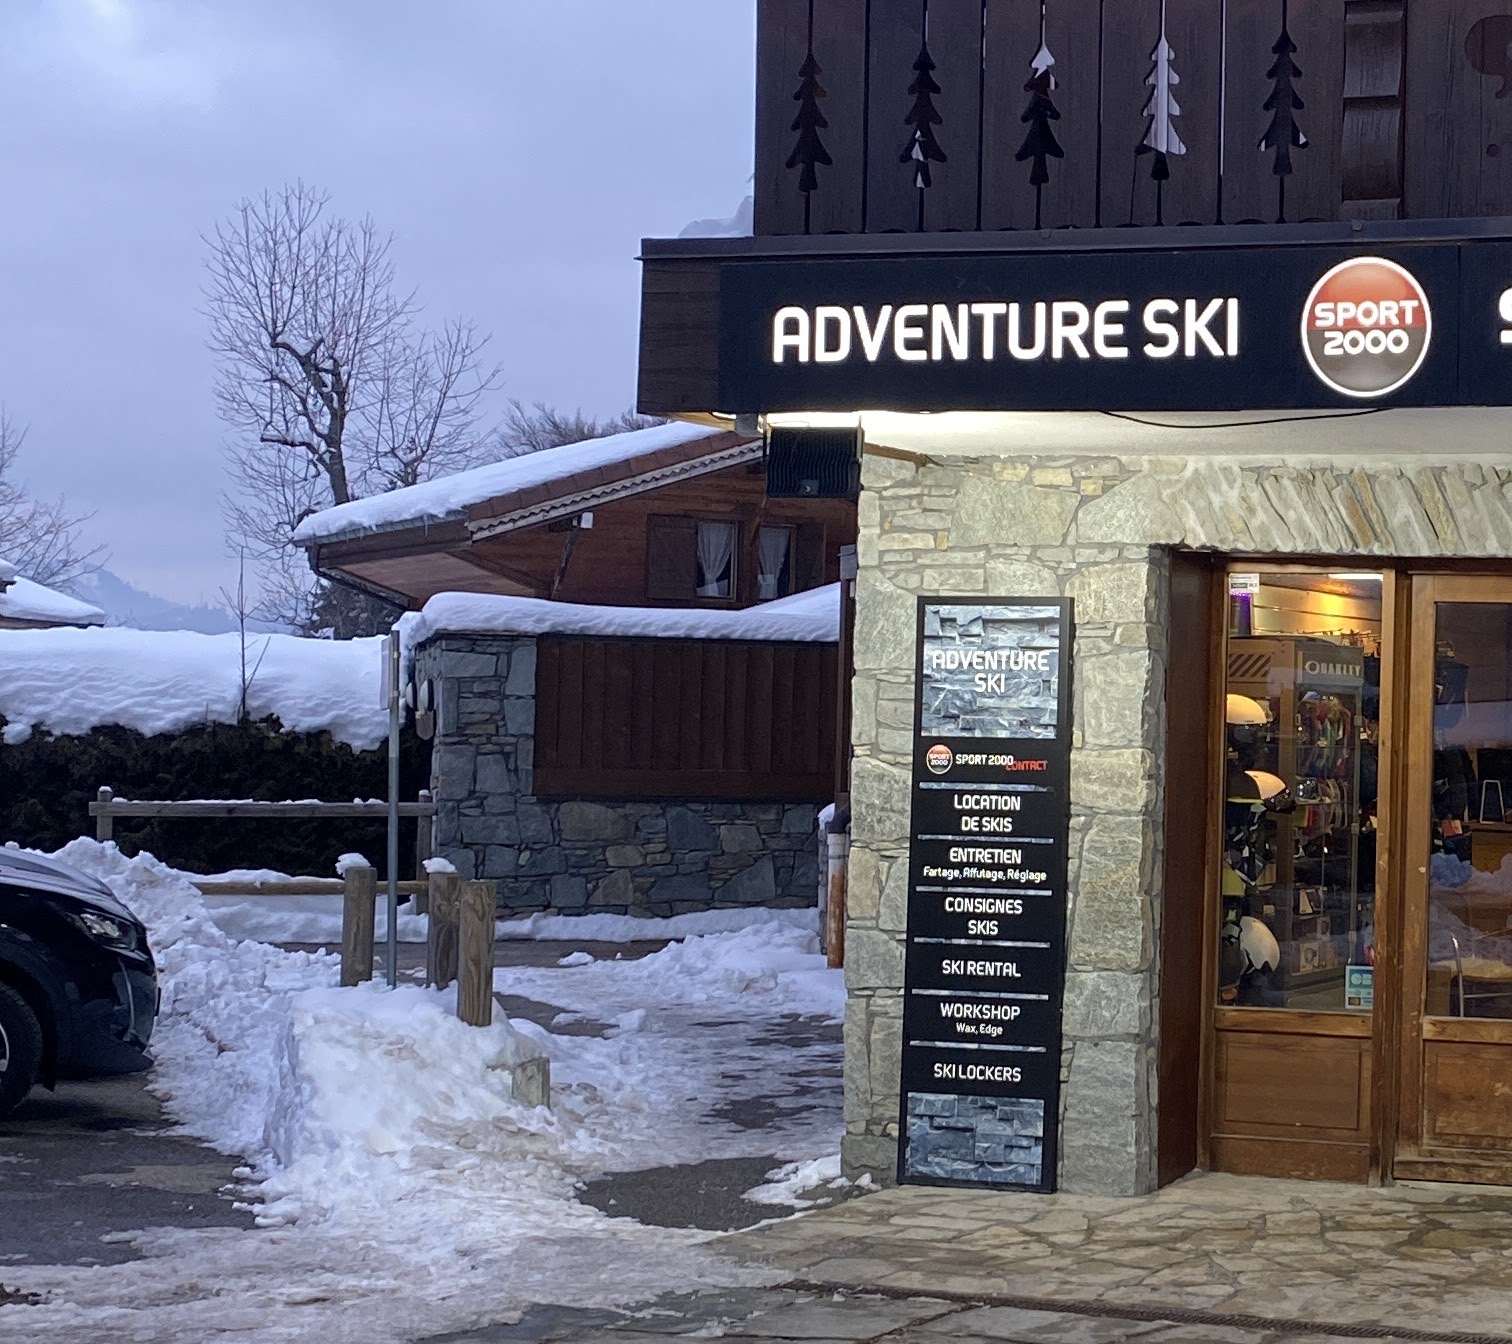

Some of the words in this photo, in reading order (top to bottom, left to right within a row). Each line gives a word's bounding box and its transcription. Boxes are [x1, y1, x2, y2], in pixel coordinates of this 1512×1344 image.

[1315, 299, 1418, 328] SPORT
[772, 299, 1130, 364] ADVENTURE
[1144, 297, 1238, 357] SKI
[1324, 330, 1409, 355] 2000
[932, 650, 1050, 671] ADVENTURE
[974, 673, 1005, 693] SKI
[956, 754, 987, 766] SPORT
[988, 755, 1014, 766] 2000
[1006, 760, 1048, 771] CONTACT
[954, 794, 1021, 811] LOCATION
[961, 816, 981, 831] DE
[982, 817, 1012, 833] SKIS
[950, 848, 1022, 864] ENTRETIEN
[1007, 869, 1047, 882] Réglage
[945, 897, 1023, 914] CONSIGNES
[968, 920, 998, 935] SKIS
[942, 960, 964, 975] SKI
[966, 961, 1021, 977] RENTAL
[940, 1003, 1020, 1020] WORKSHOP
[956, 1022, 978, 1035] Wax,
[979, 1024, 1003, 1036] Edge
[934, 1063, 955, 1078] SKI
[958, 1064, 1022, 1082] LOCKERS
